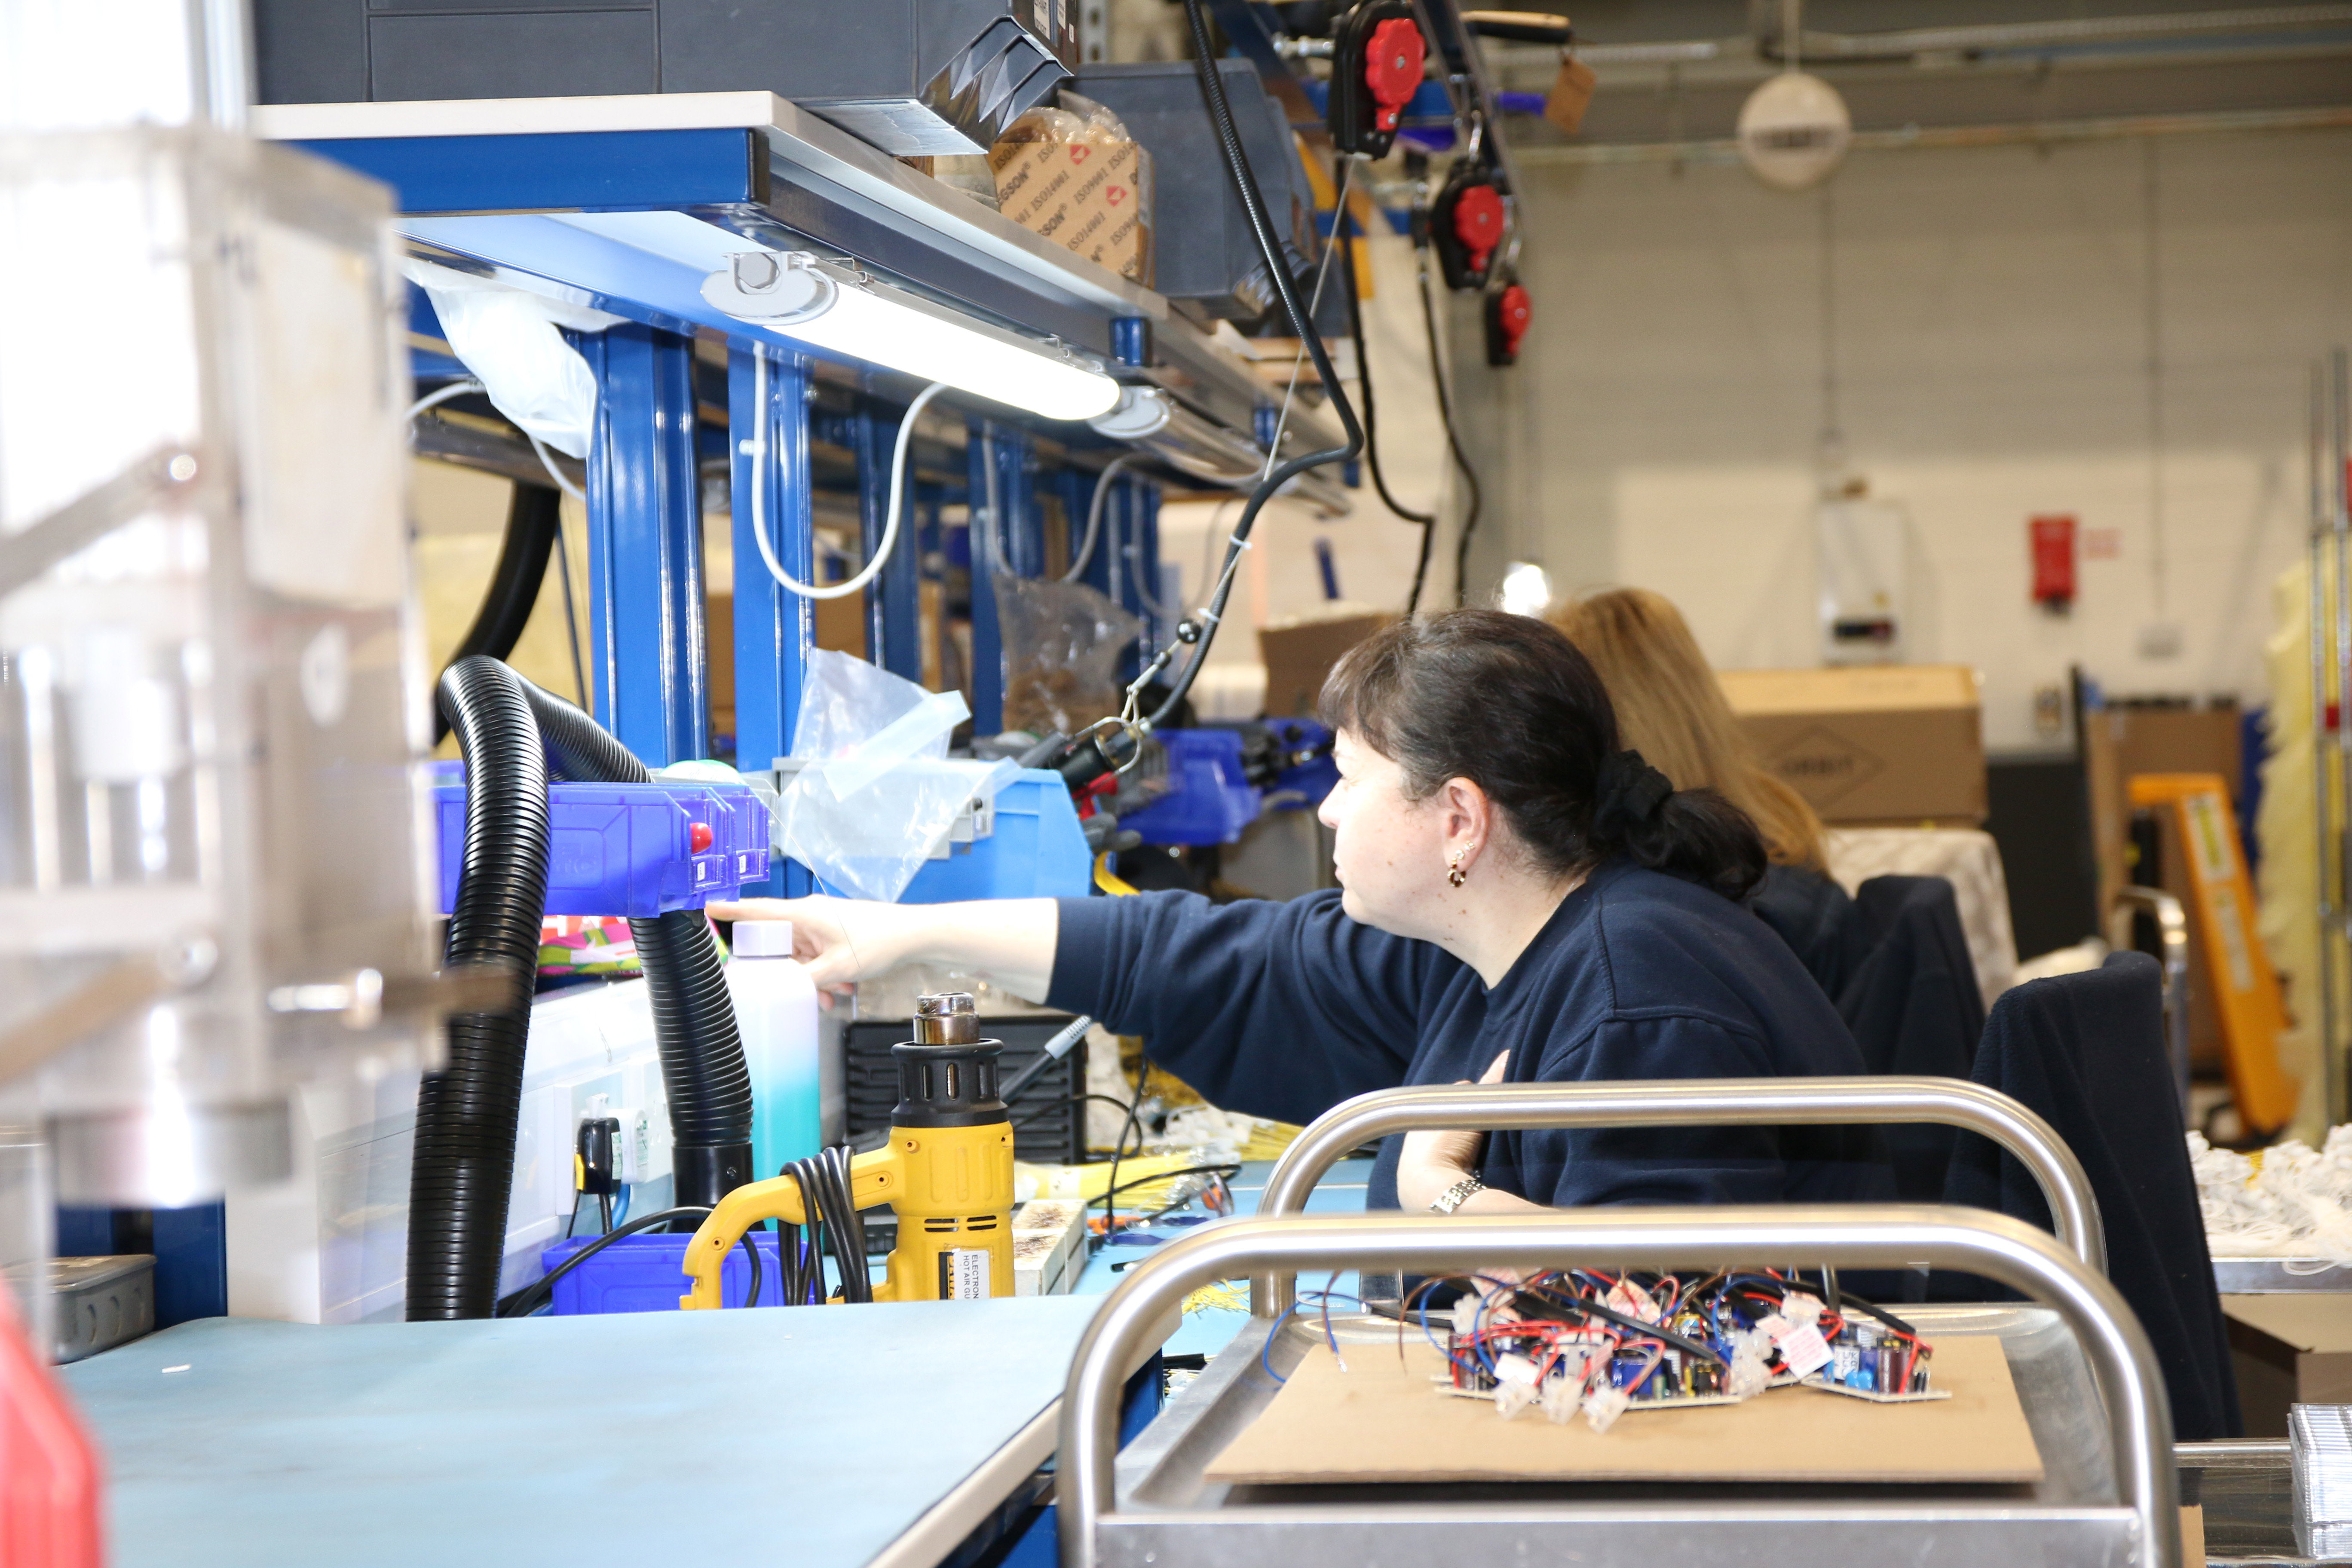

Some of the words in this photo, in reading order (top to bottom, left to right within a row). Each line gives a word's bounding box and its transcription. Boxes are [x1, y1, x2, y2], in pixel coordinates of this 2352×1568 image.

[1031, 169, 1069, 211] ISO14001
[1073, 167, 1109, 205] ISO9001
[1066, 211, 1106, 251] ISO14001
